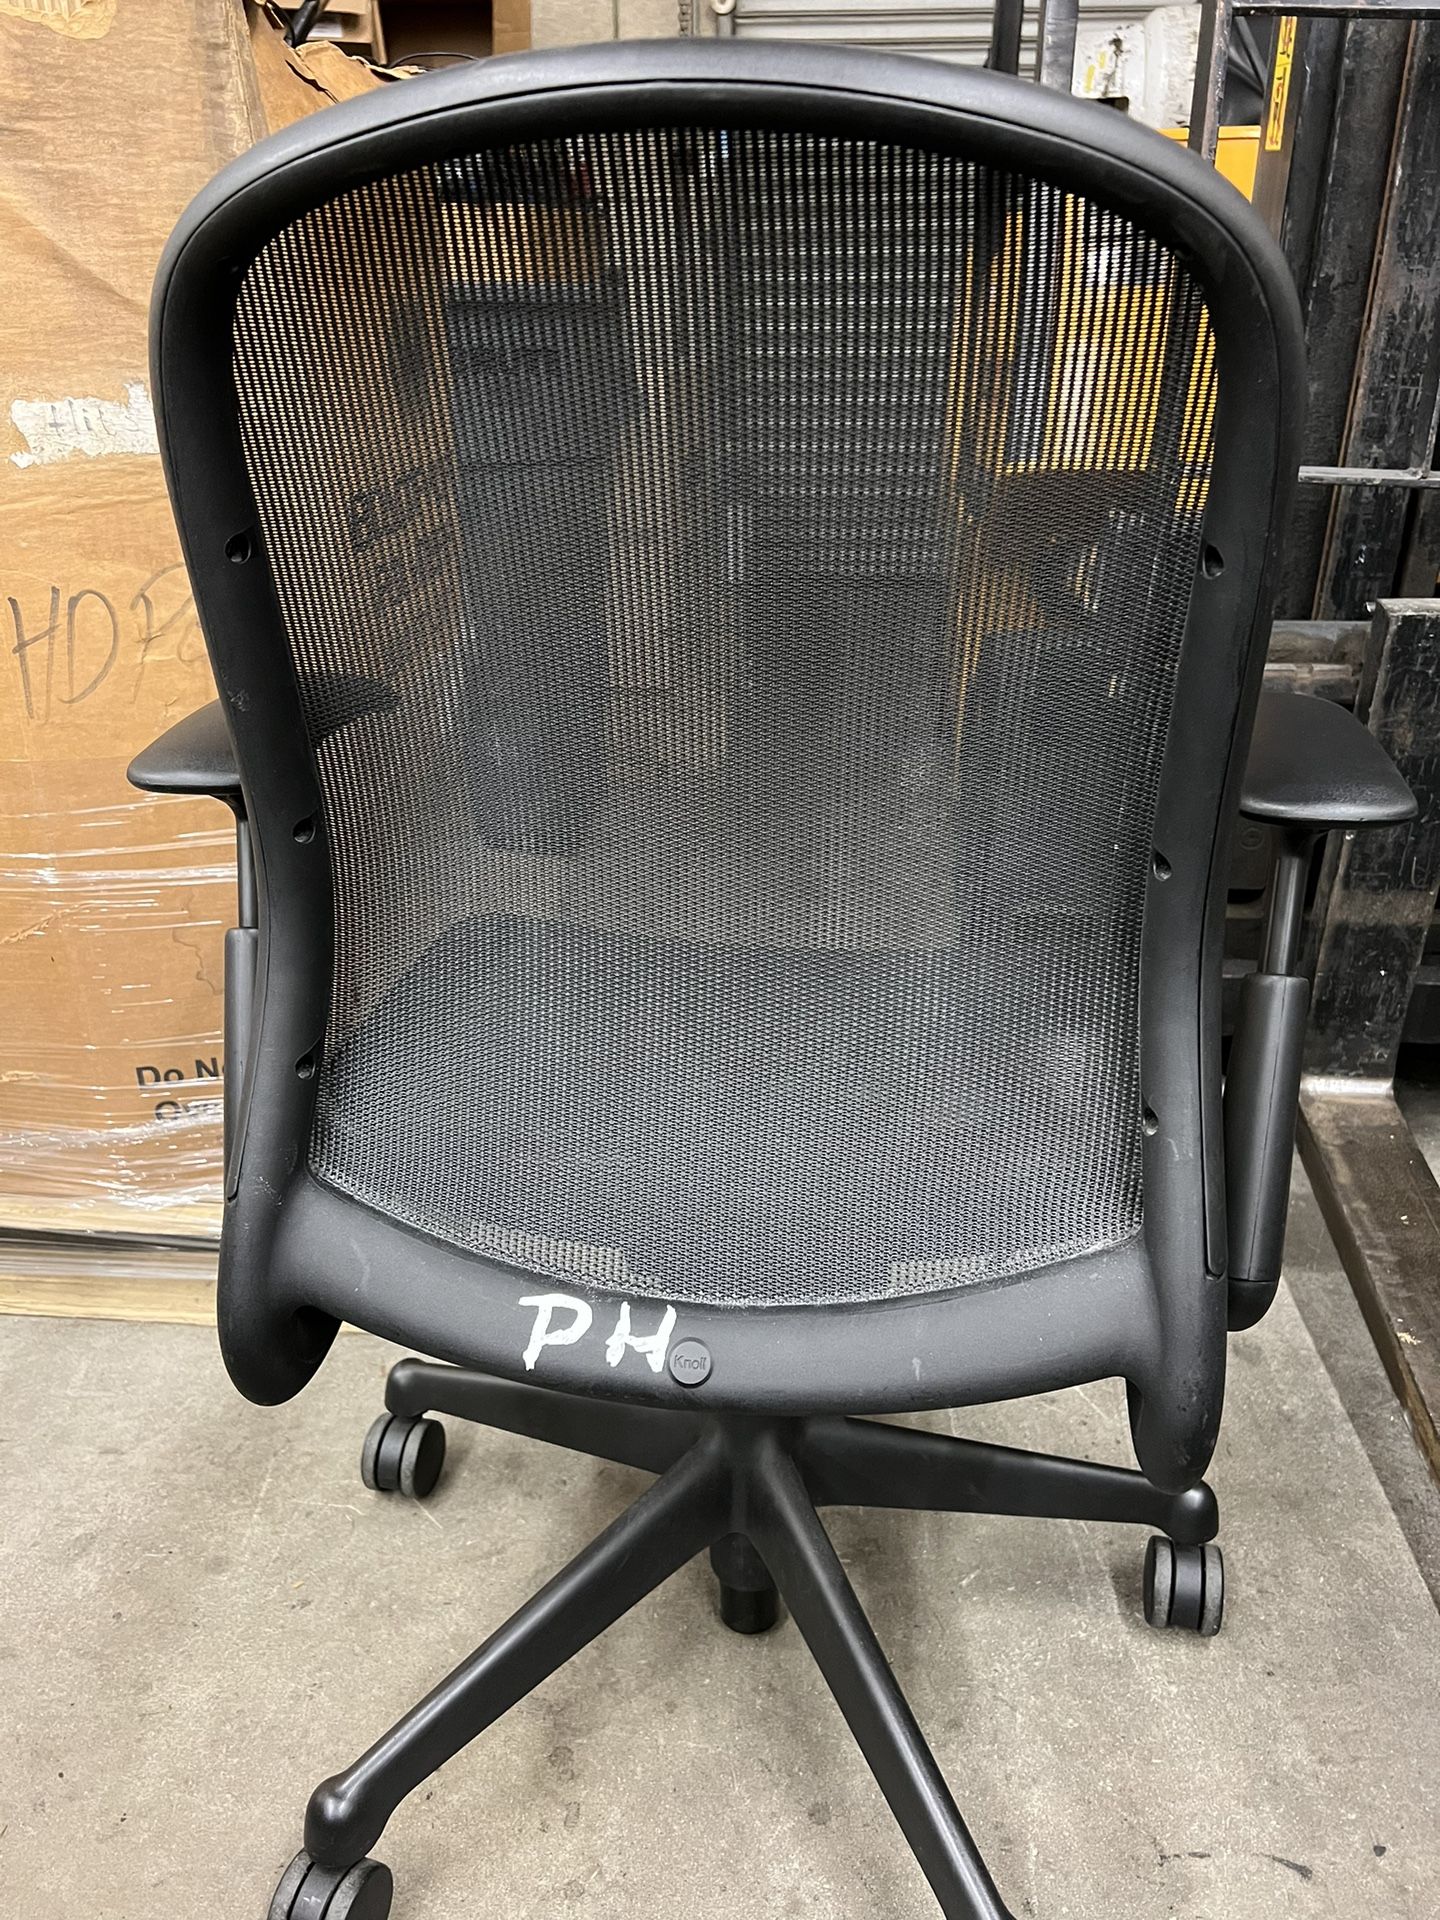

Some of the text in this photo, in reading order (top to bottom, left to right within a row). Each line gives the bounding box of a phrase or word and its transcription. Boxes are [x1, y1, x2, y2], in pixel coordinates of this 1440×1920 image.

[8, 585, 119, 722] HD
[136, 1057, 225, 1087] Do N
[673, 1354, 707, 1371] Knoll
